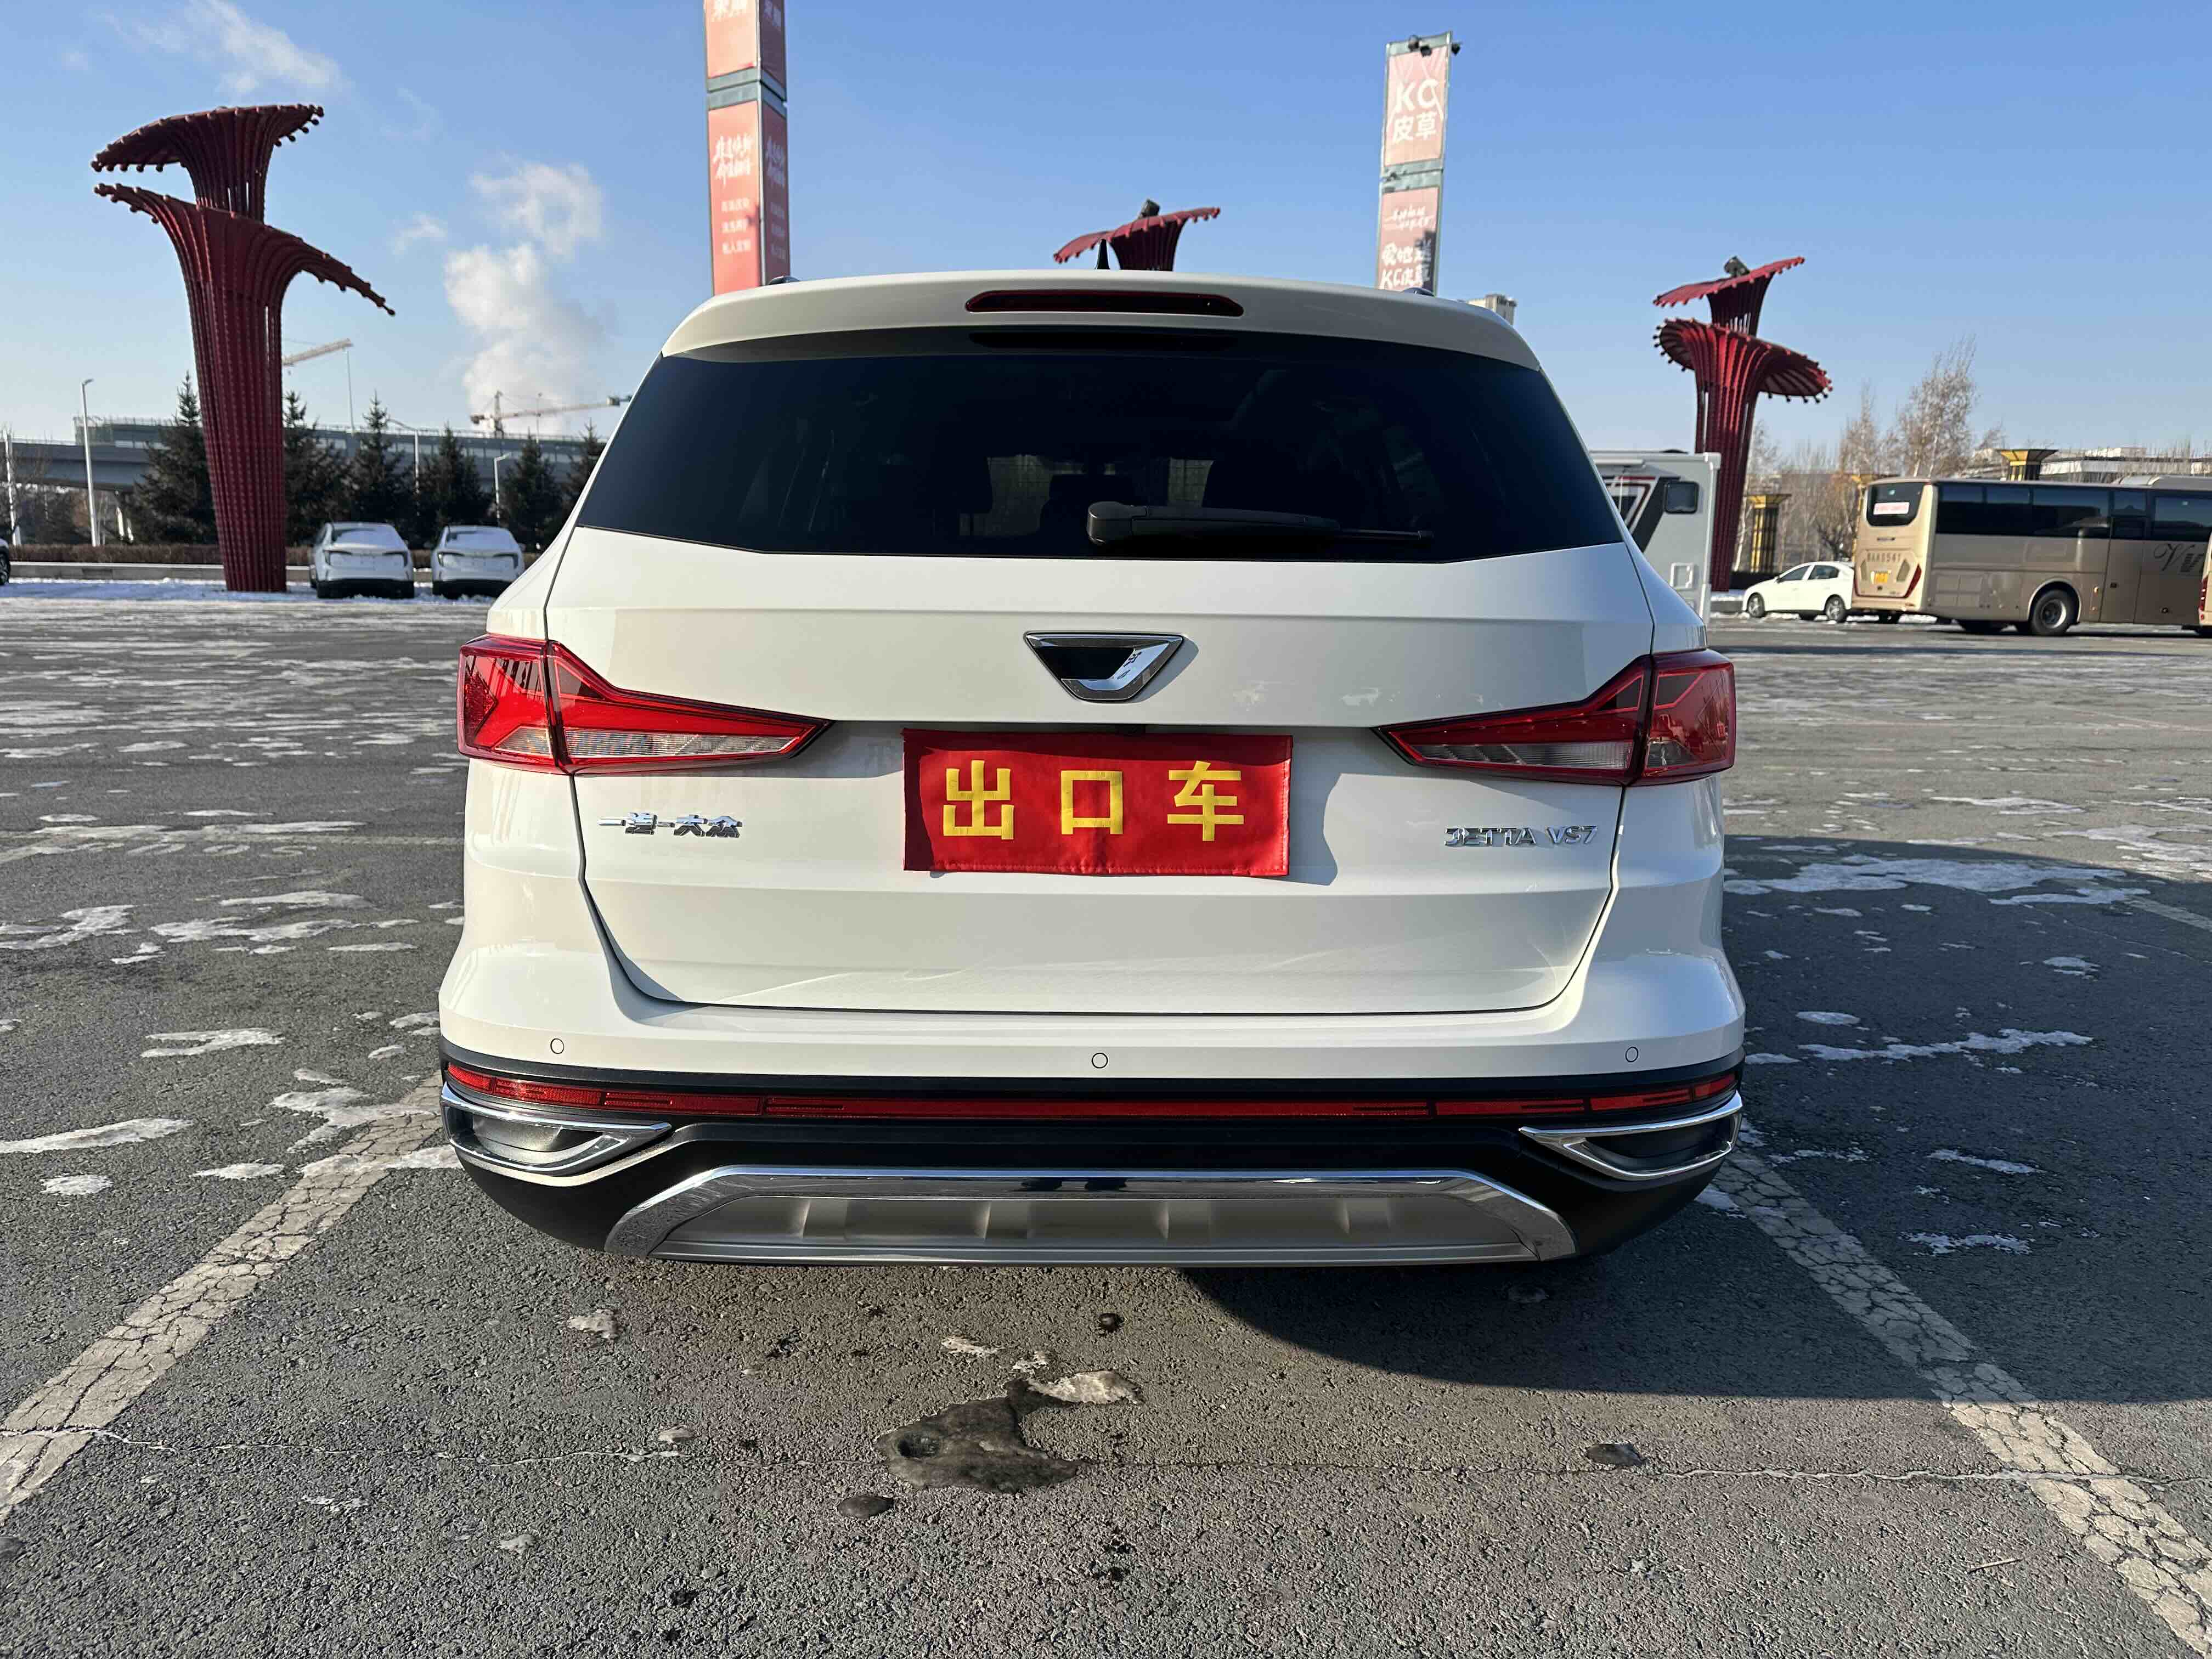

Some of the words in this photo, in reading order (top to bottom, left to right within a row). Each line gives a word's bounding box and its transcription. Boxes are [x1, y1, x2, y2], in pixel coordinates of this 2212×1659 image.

[1396, 79, 1438, 112] KC
[1393, 112, 1436, 143] 皮草
[943, 759, 1244, 841] 出口车
[1444, 827, 1536, 846] JETTA
[1546, 825, 1598, 844] VS7
